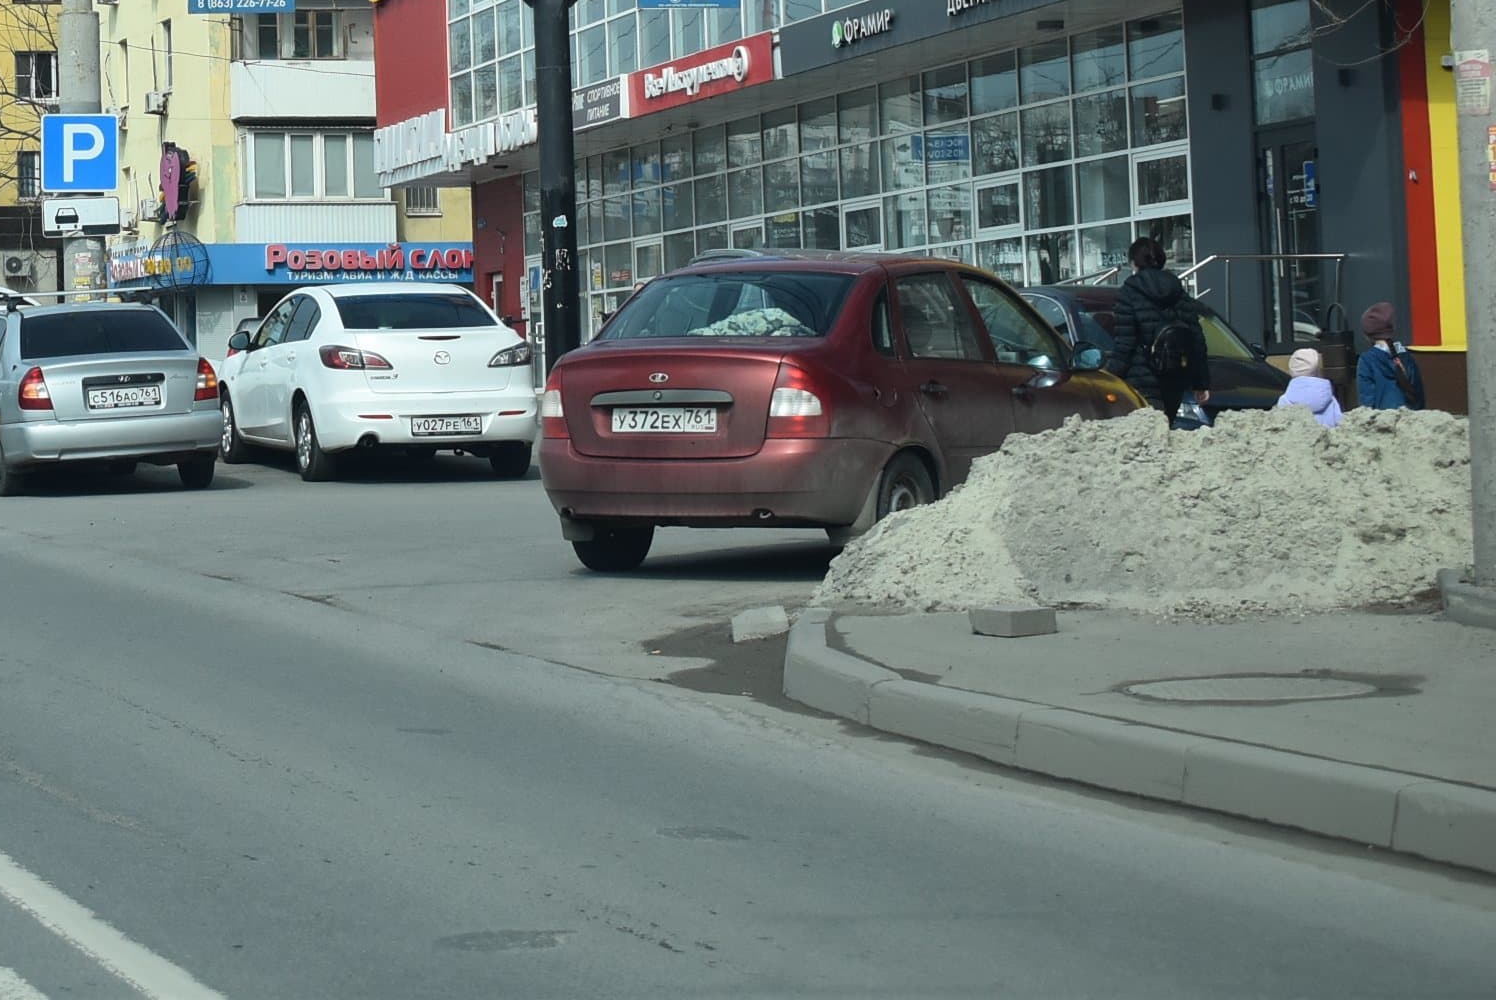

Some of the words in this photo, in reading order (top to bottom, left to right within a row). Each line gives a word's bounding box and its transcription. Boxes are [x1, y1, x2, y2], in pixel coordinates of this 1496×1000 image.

[843, 8, 891, 44] ФРАМИР
[62, 123, 105, 183] P
[286, 271, 334, 281] ТУРИЗМ
[342, 271, 372, 281] АВИА
[418, 271, 459, 280] КАССЫ
